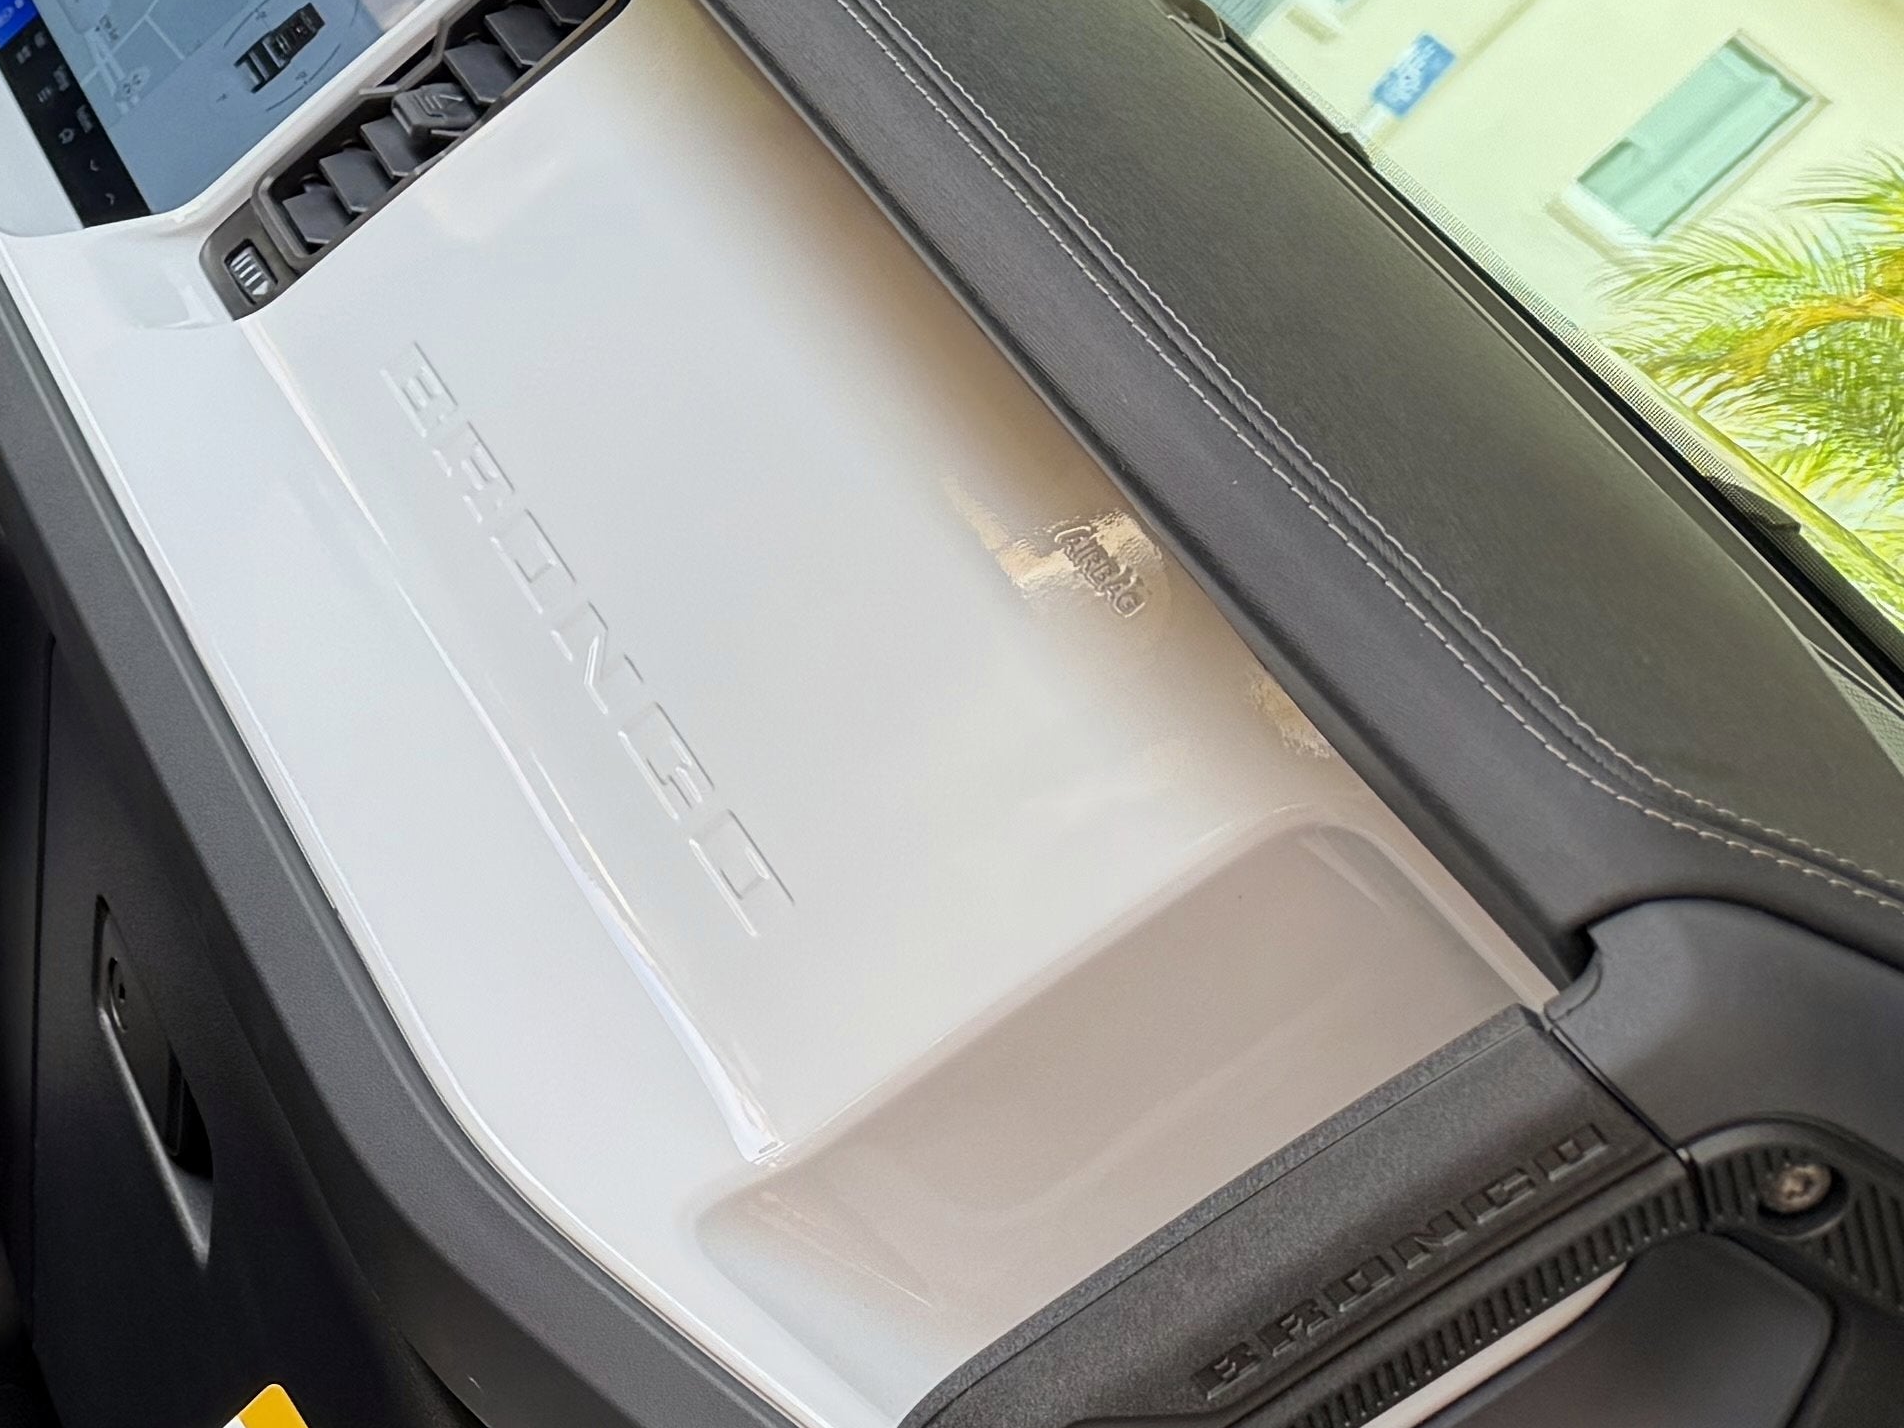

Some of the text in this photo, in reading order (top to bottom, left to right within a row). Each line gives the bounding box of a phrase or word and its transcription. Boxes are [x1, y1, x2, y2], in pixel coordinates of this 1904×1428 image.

[381, 340, 795, 937] BRONCO
[1055, 526, 1147, 618] AIRBAG
[1195, 1123, 1608, 1401] BRONCO
